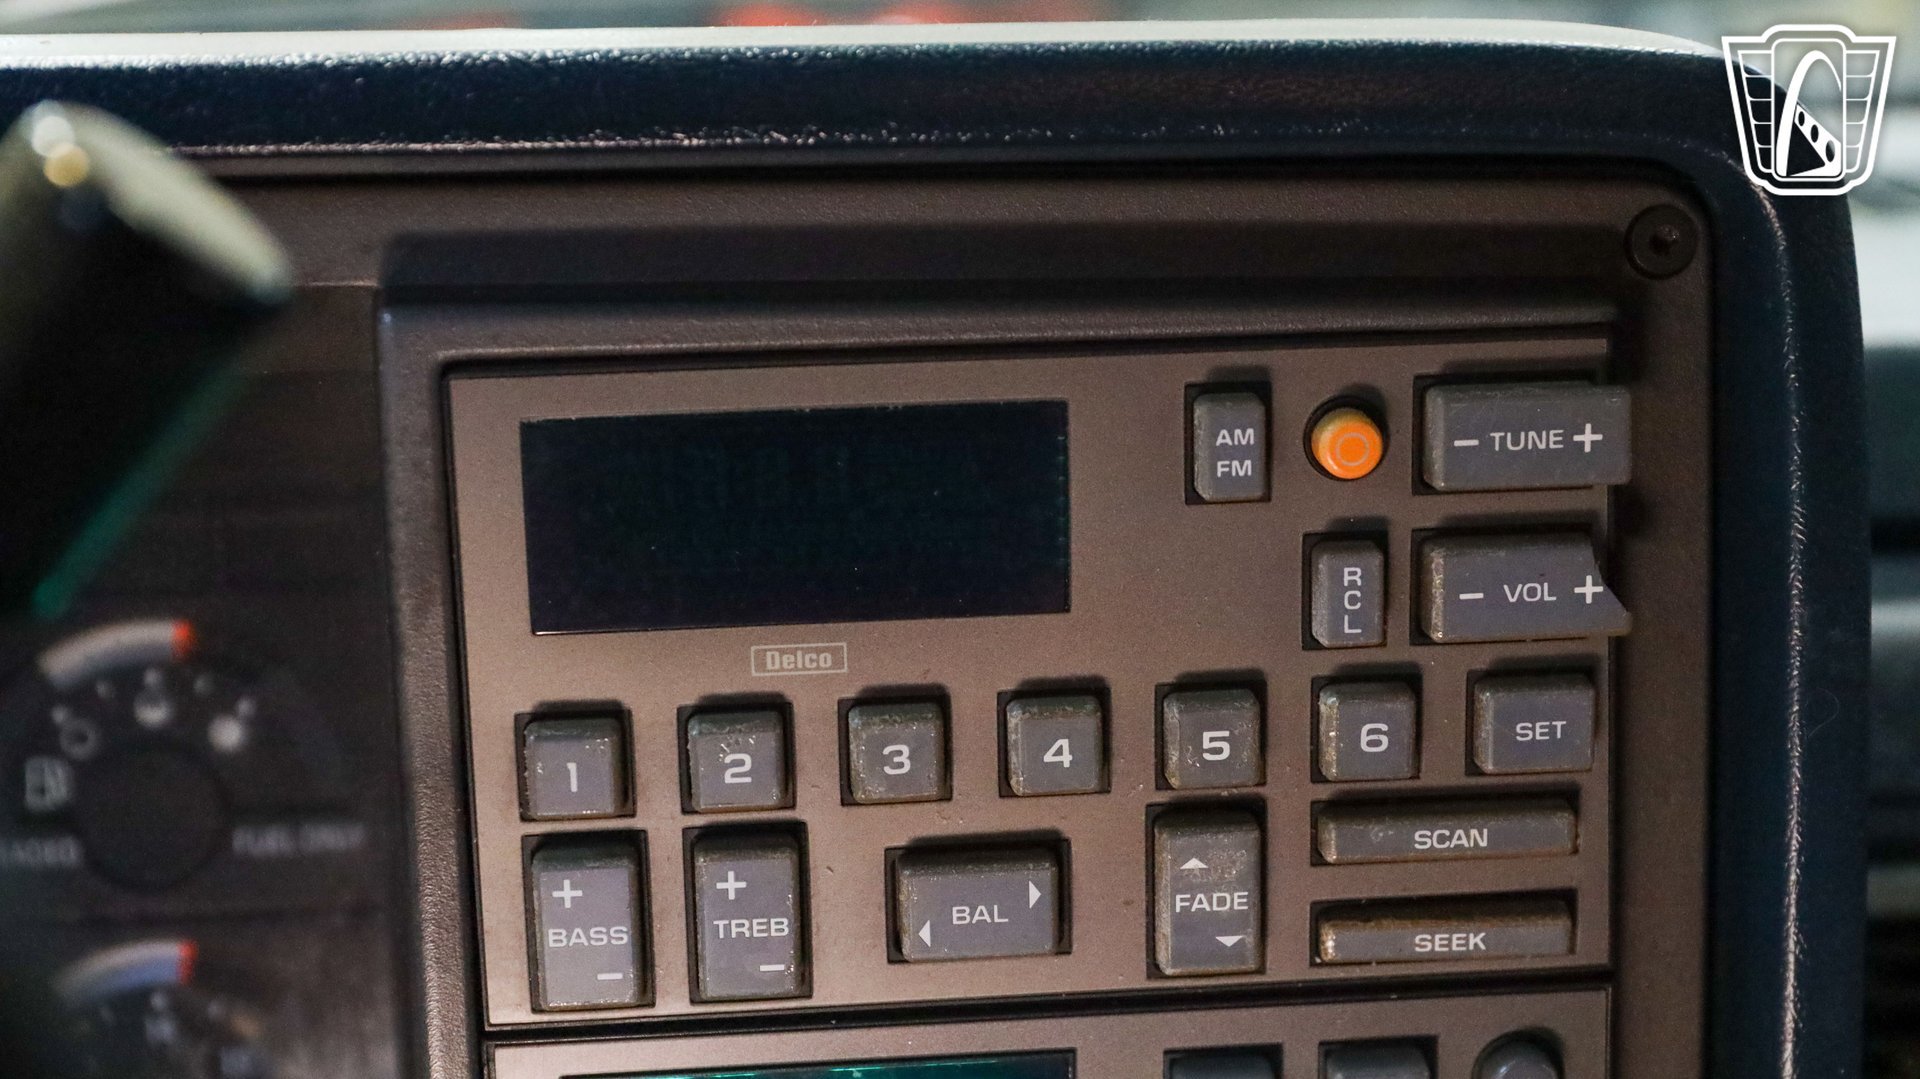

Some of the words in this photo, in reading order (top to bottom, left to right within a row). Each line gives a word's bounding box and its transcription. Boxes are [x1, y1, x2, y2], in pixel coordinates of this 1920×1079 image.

[1215, 428, 1255, 447] AM
[1489, 429, 1564, 452] TUNE
[1216, 459, 1252, 478] FM
[1343, 566, 1362, 634] RCL
[1503, 582, 1557, 603] VOL
[765, 650, 833, 671] Delco
[1360, 723, 1389, 753] 6
[1515, 720, 1567, 742] SET
[1043, 738, 1073, 768] 4
[1202, 730, 1231, 761] 5
[724, 753, 752, 784] 2
[882, 744, 911, 775] 3
[566, 762, 578, 793] 1
[1414, 828, 1488, 850] SCAN
[1175, 891, 1249, 913] FADE
[952, 904, 1009, 925] BAL
[547, 926, 628, 948] BASS
[712, 917, 789, 939] TREB
[1414, 932, 1486, 952] SEEK
